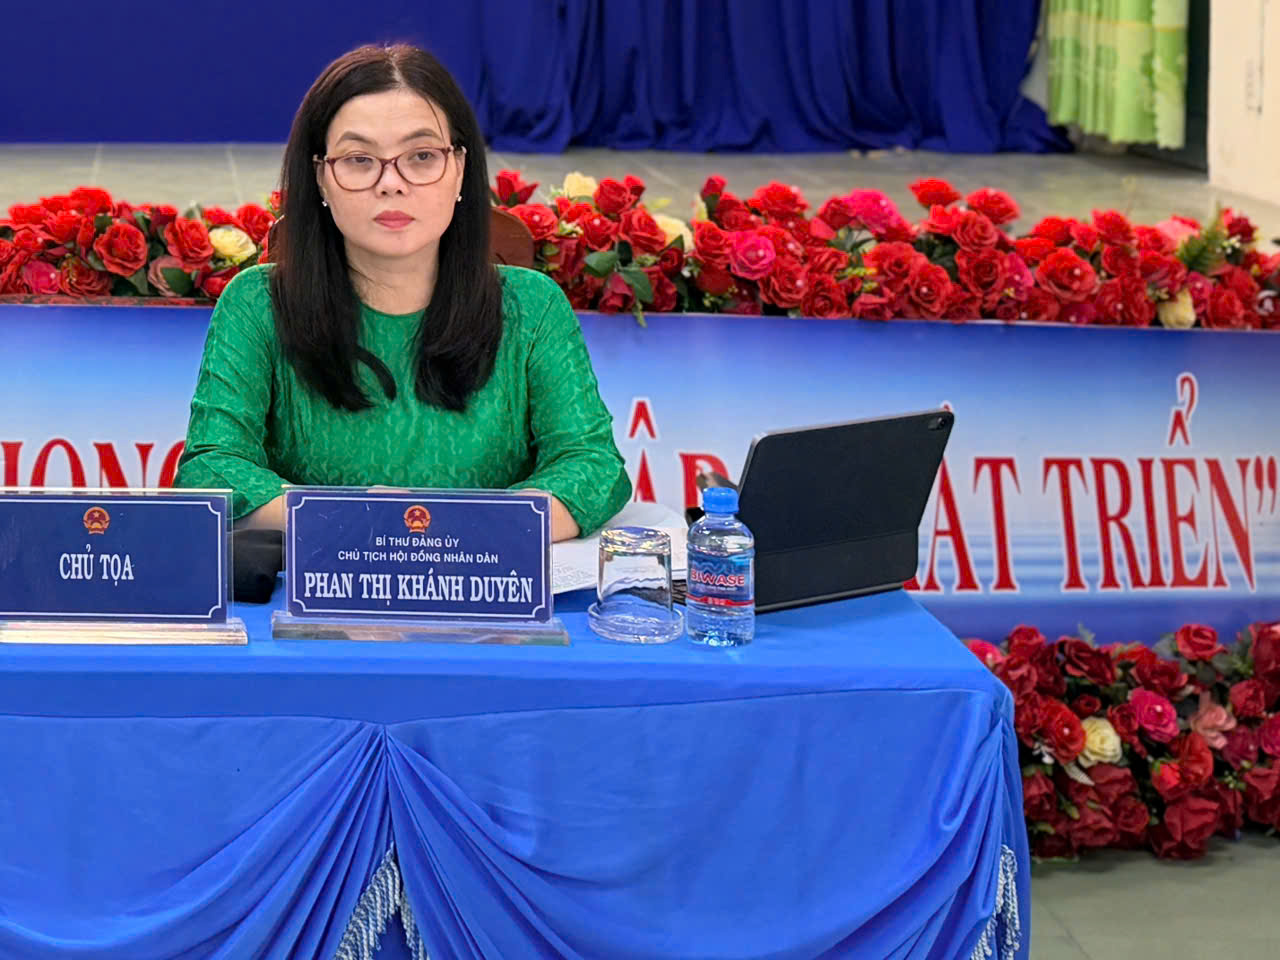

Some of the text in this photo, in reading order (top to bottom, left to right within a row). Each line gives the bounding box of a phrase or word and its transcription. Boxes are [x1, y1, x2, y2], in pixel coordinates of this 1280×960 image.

[375, 535, 460, 548] BÍ THƯ ĐẢNG ỦY
[60, 543, 135, 586] CHỦ TỌA
[338, 549, 360, 561] CHỦ
[362, 551, 387, 563] TỊCH
[389, 550, 408, 563] HỘI
[444, 551, 474, 564] NHÂN
[476, 551, 499, 564] DÂN
[304, 571, 354, 599] PHAN
[359, 573, 392, 606] THỊ
[397, 568, 464, 602] KHÁNH
[469, 570, 533, 603] DUYÊN
